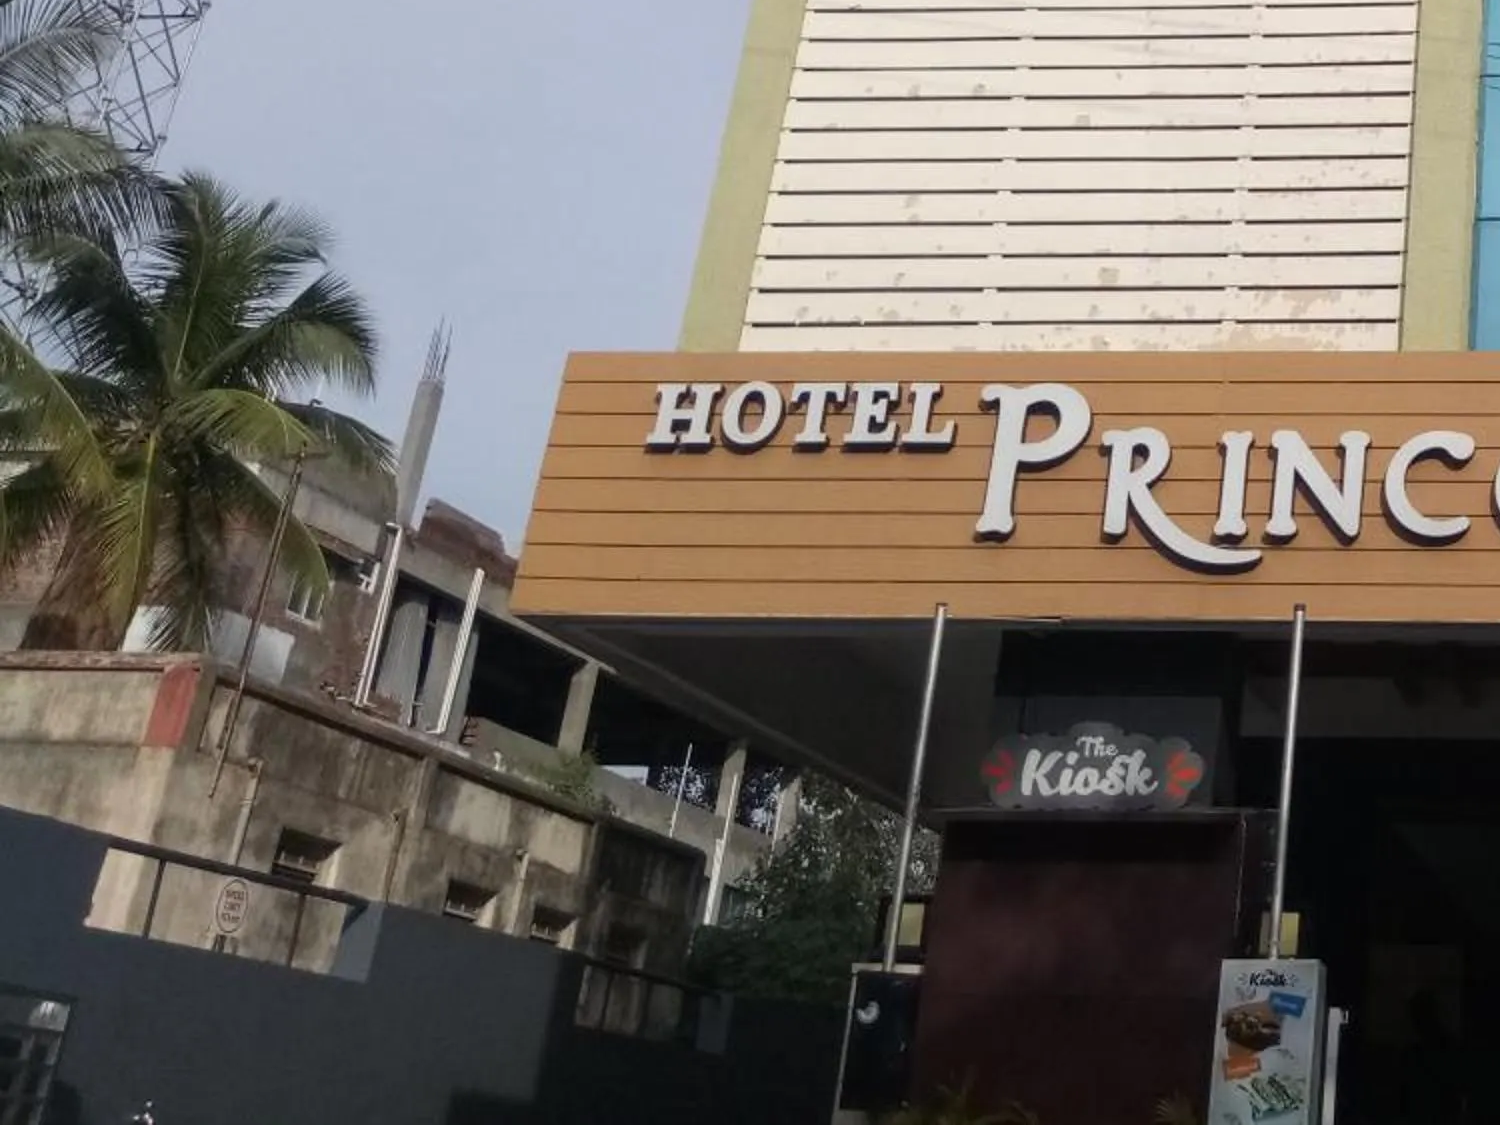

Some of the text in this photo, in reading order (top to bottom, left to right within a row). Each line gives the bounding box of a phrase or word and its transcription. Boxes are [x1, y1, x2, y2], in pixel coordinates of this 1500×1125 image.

[645, 382, 956, 451] HOTEL
[1076, 736, 1118, 757] The
[1020, 748, 1158, 796] Kiosk
